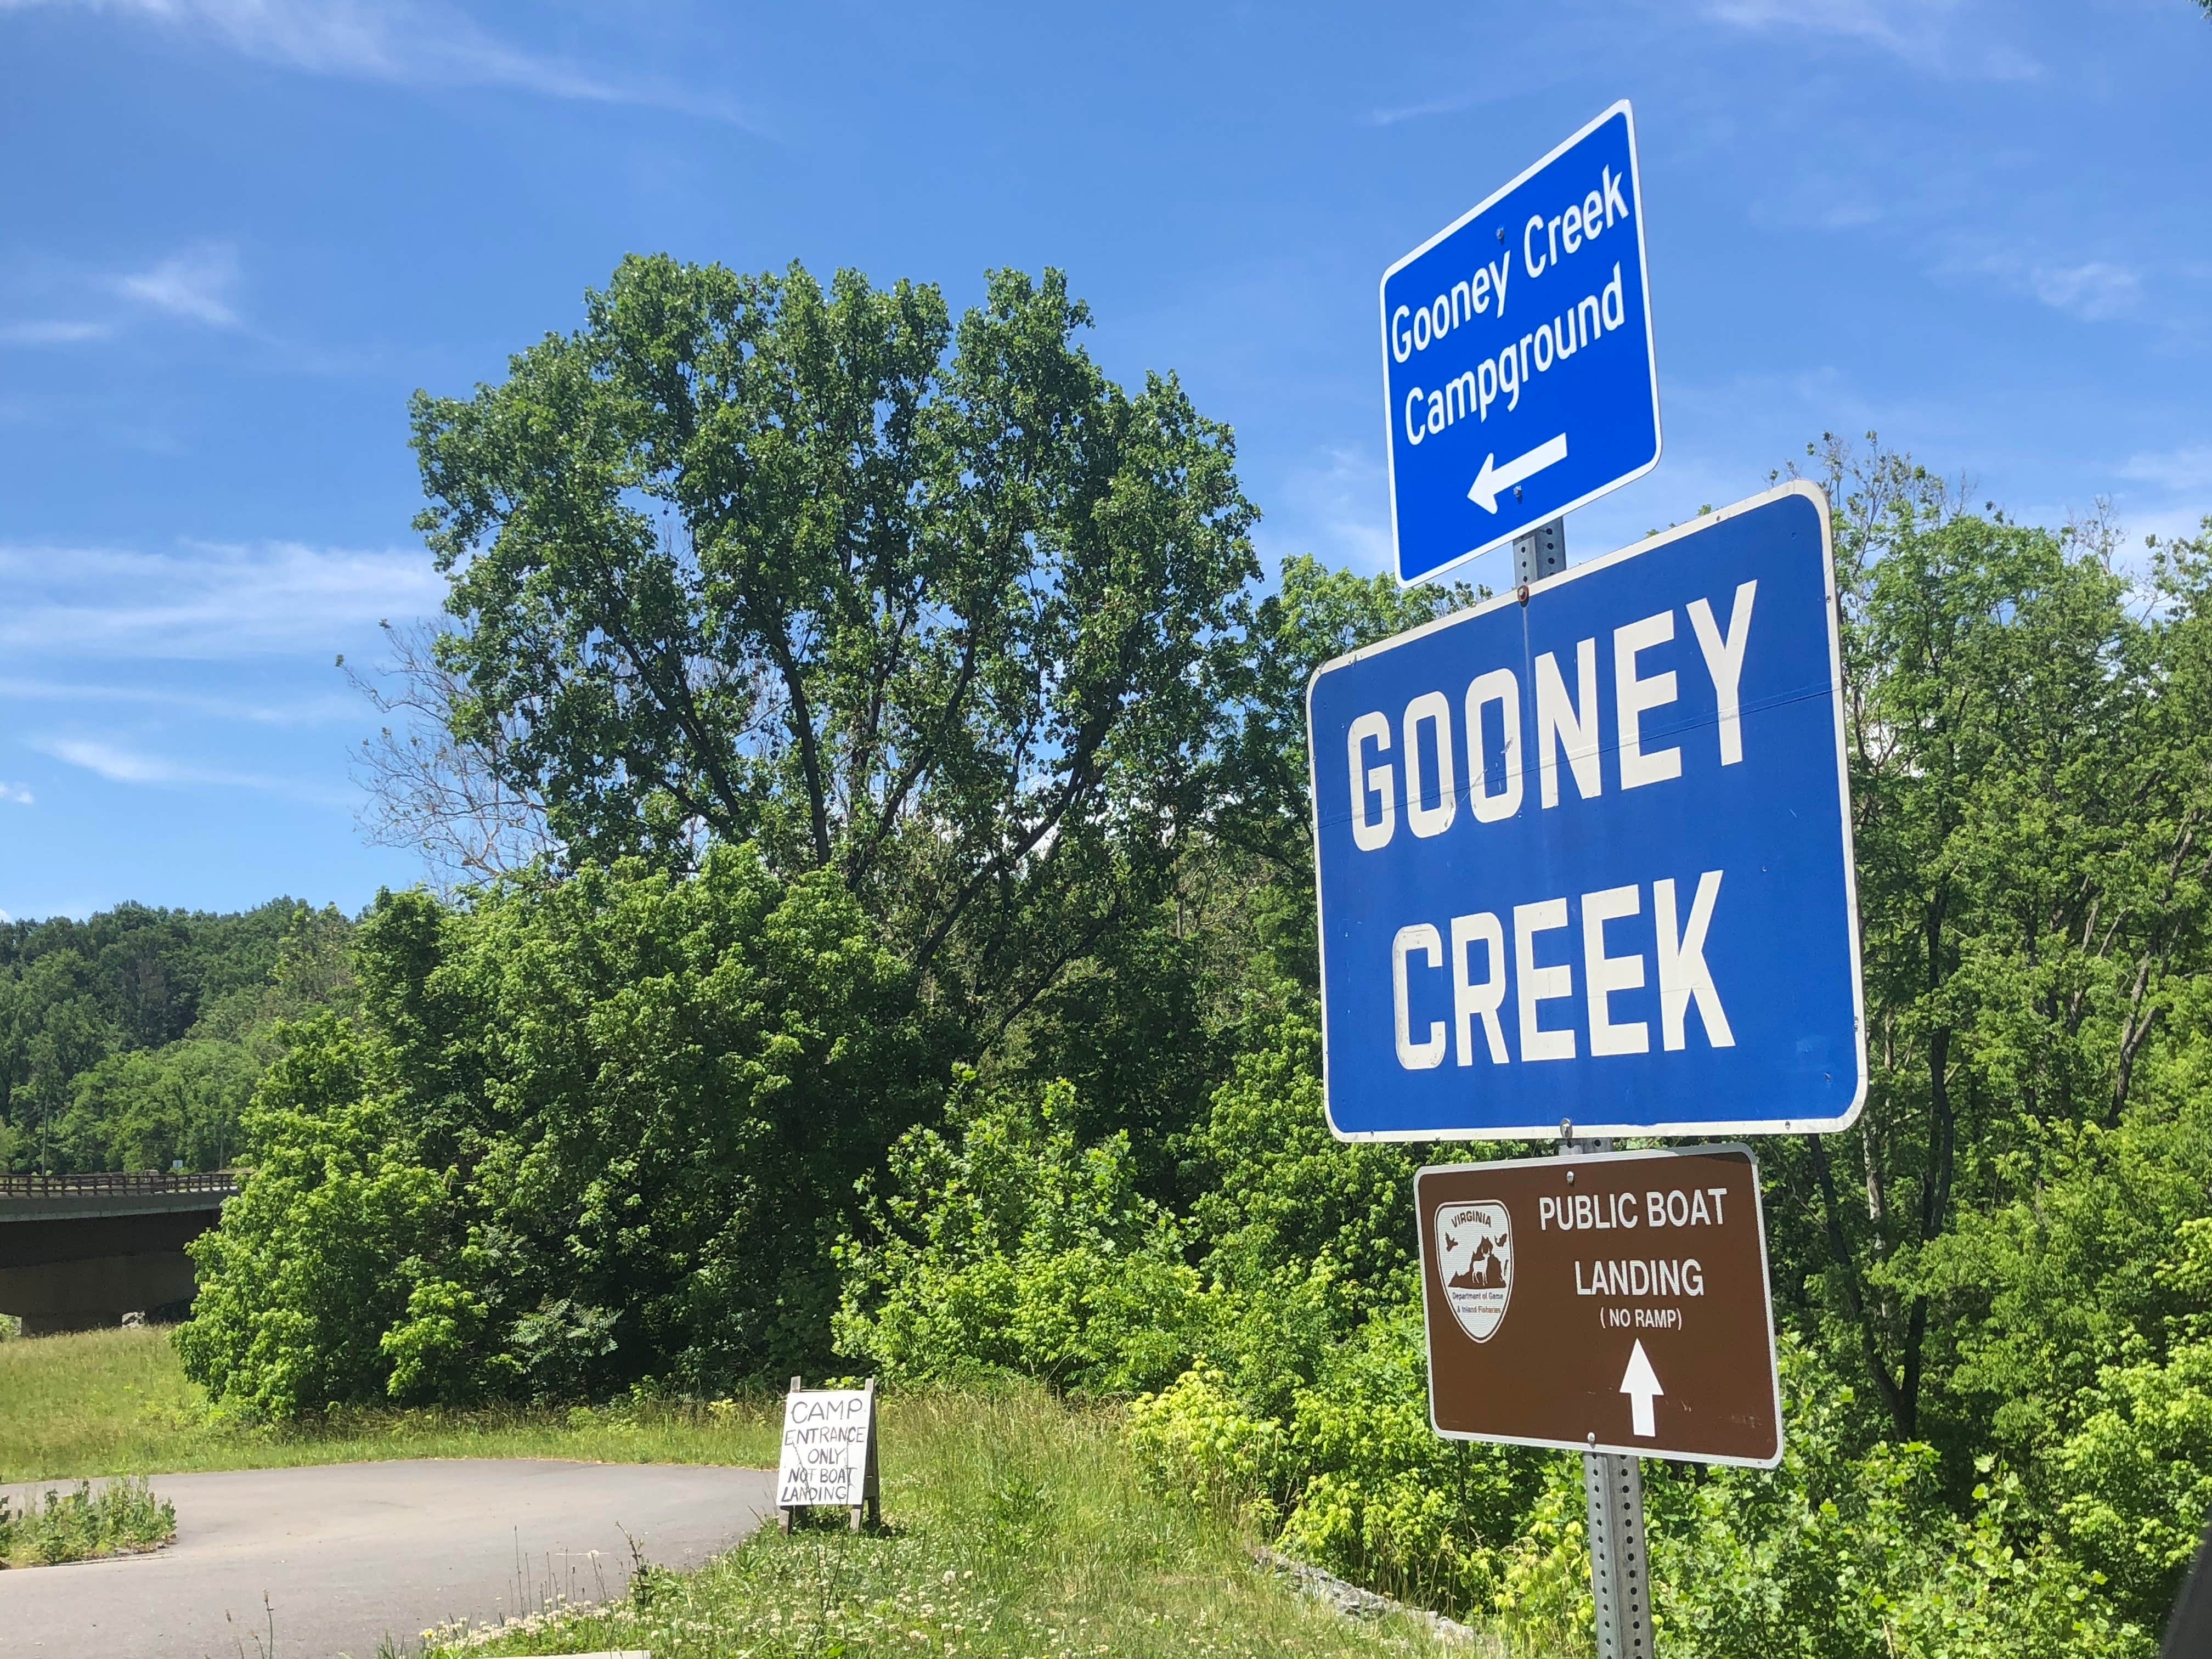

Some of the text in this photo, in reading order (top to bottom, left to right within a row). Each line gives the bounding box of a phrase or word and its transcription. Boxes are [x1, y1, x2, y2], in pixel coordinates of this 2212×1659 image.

[1391, 164, 1629, 364] Gooney Creek
[1405, 260, 1626, 445] Campground
[1347, 579, 1758, 852] GOONEY
[1392, 870, 1736, 1070] CREEK
[1451, 1210, 1492, 1228] VIRGINIA
[1539, 1188, 1728, 1231] PUBLIC BOAT
[1575, 1259, 1704, 1296] LANDING
[1634, 1307, 1683, 1331] RAMP)
[791, 1398, 863, 1424] CAMP
[785, 1426, 866, 1446] ENTRANCE
[808, 1448, 846, 1465] ONLY
[788, 1467, 857, 1484] NOT BOAT
[781, 1486, 847, 1503] LANDING
